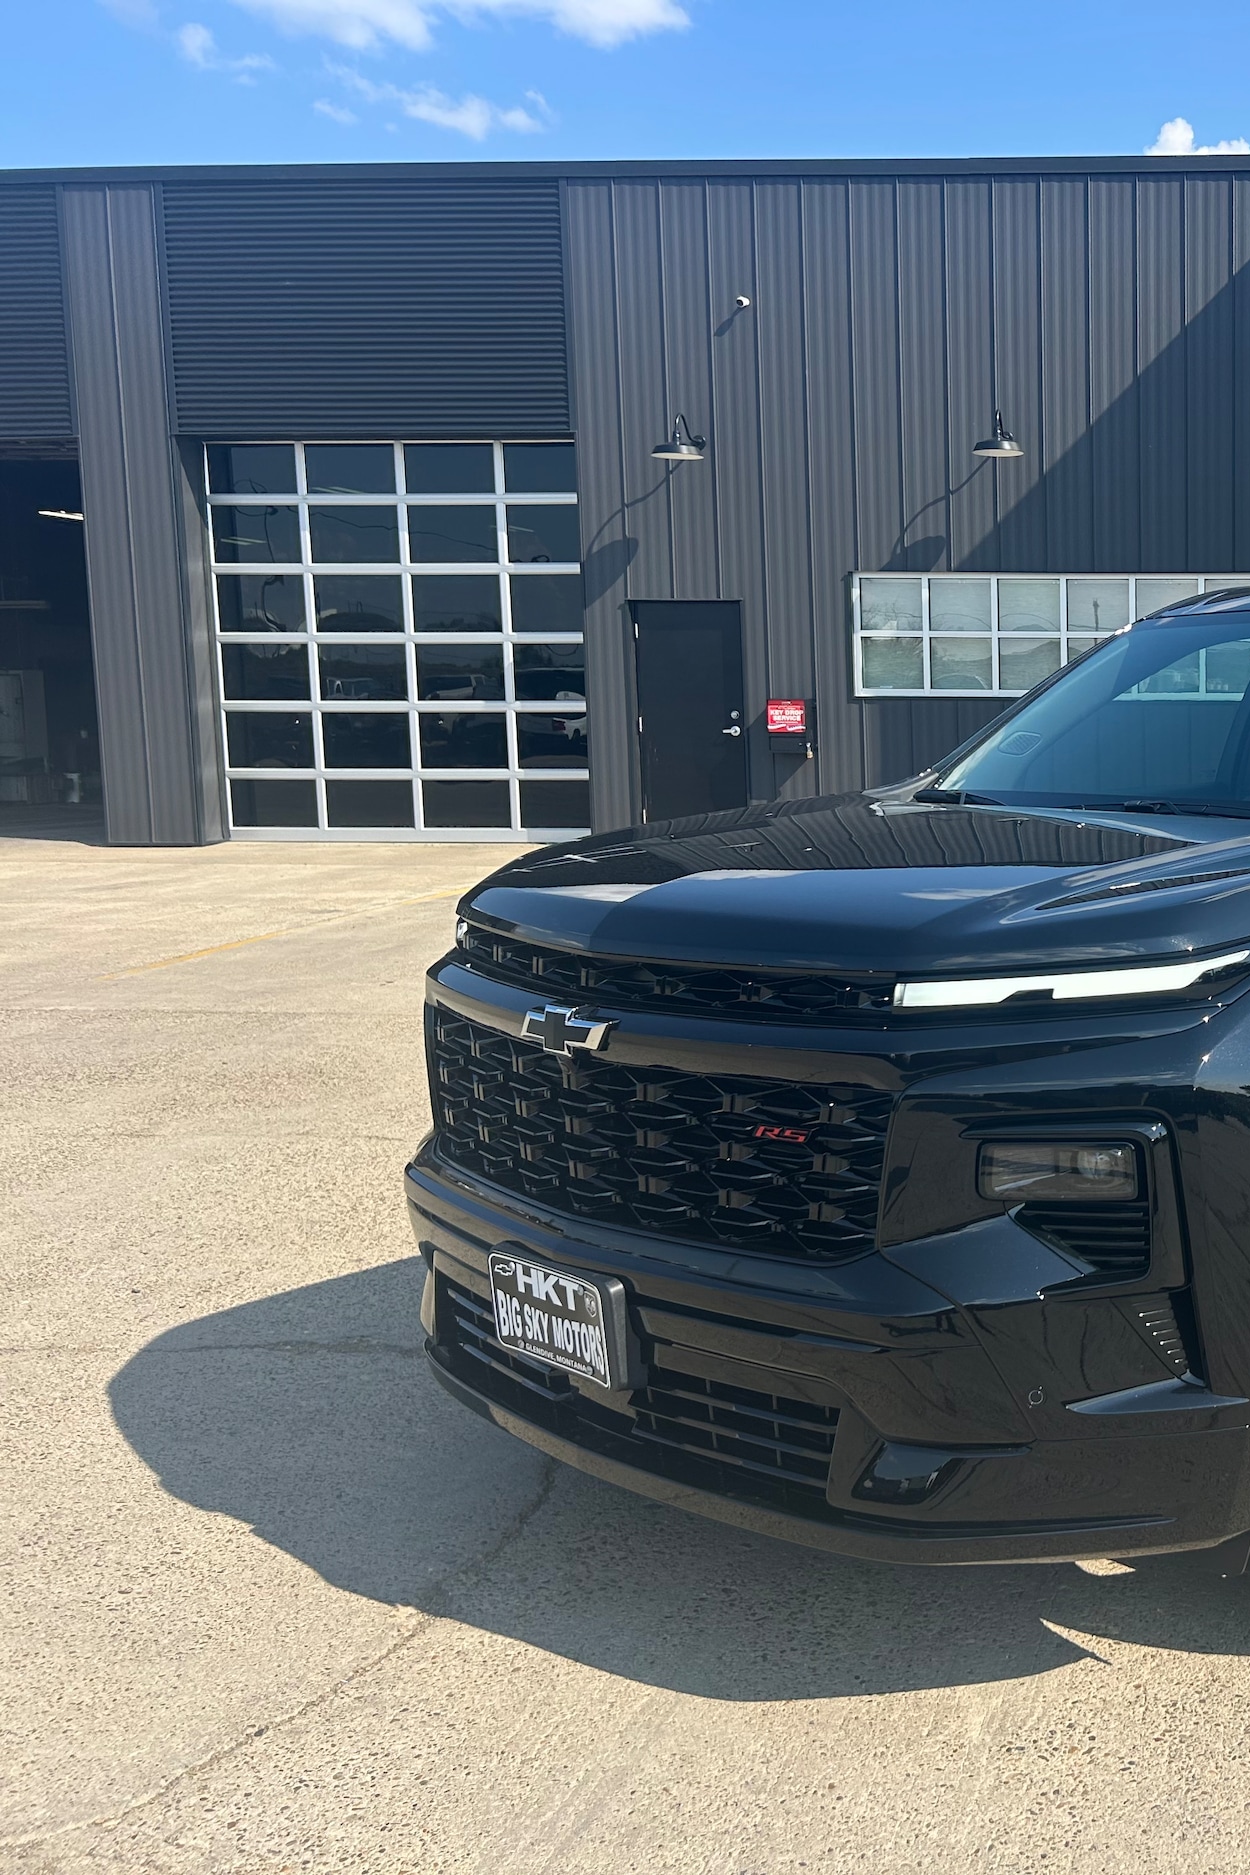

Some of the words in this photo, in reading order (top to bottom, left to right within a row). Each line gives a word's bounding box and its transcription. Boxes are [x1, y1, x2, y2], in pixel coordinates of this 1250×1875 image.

[754, 1124, 810, 1143] RS
[515, 1262, 580, 1312] HKT
[496, 1288, 523, 1338] BIG
[523, 1303, 549, 1344] SKY
[551, 1315, 605, 1376] MOTORS
[556, 1354, 587, 1372] MONTANA
